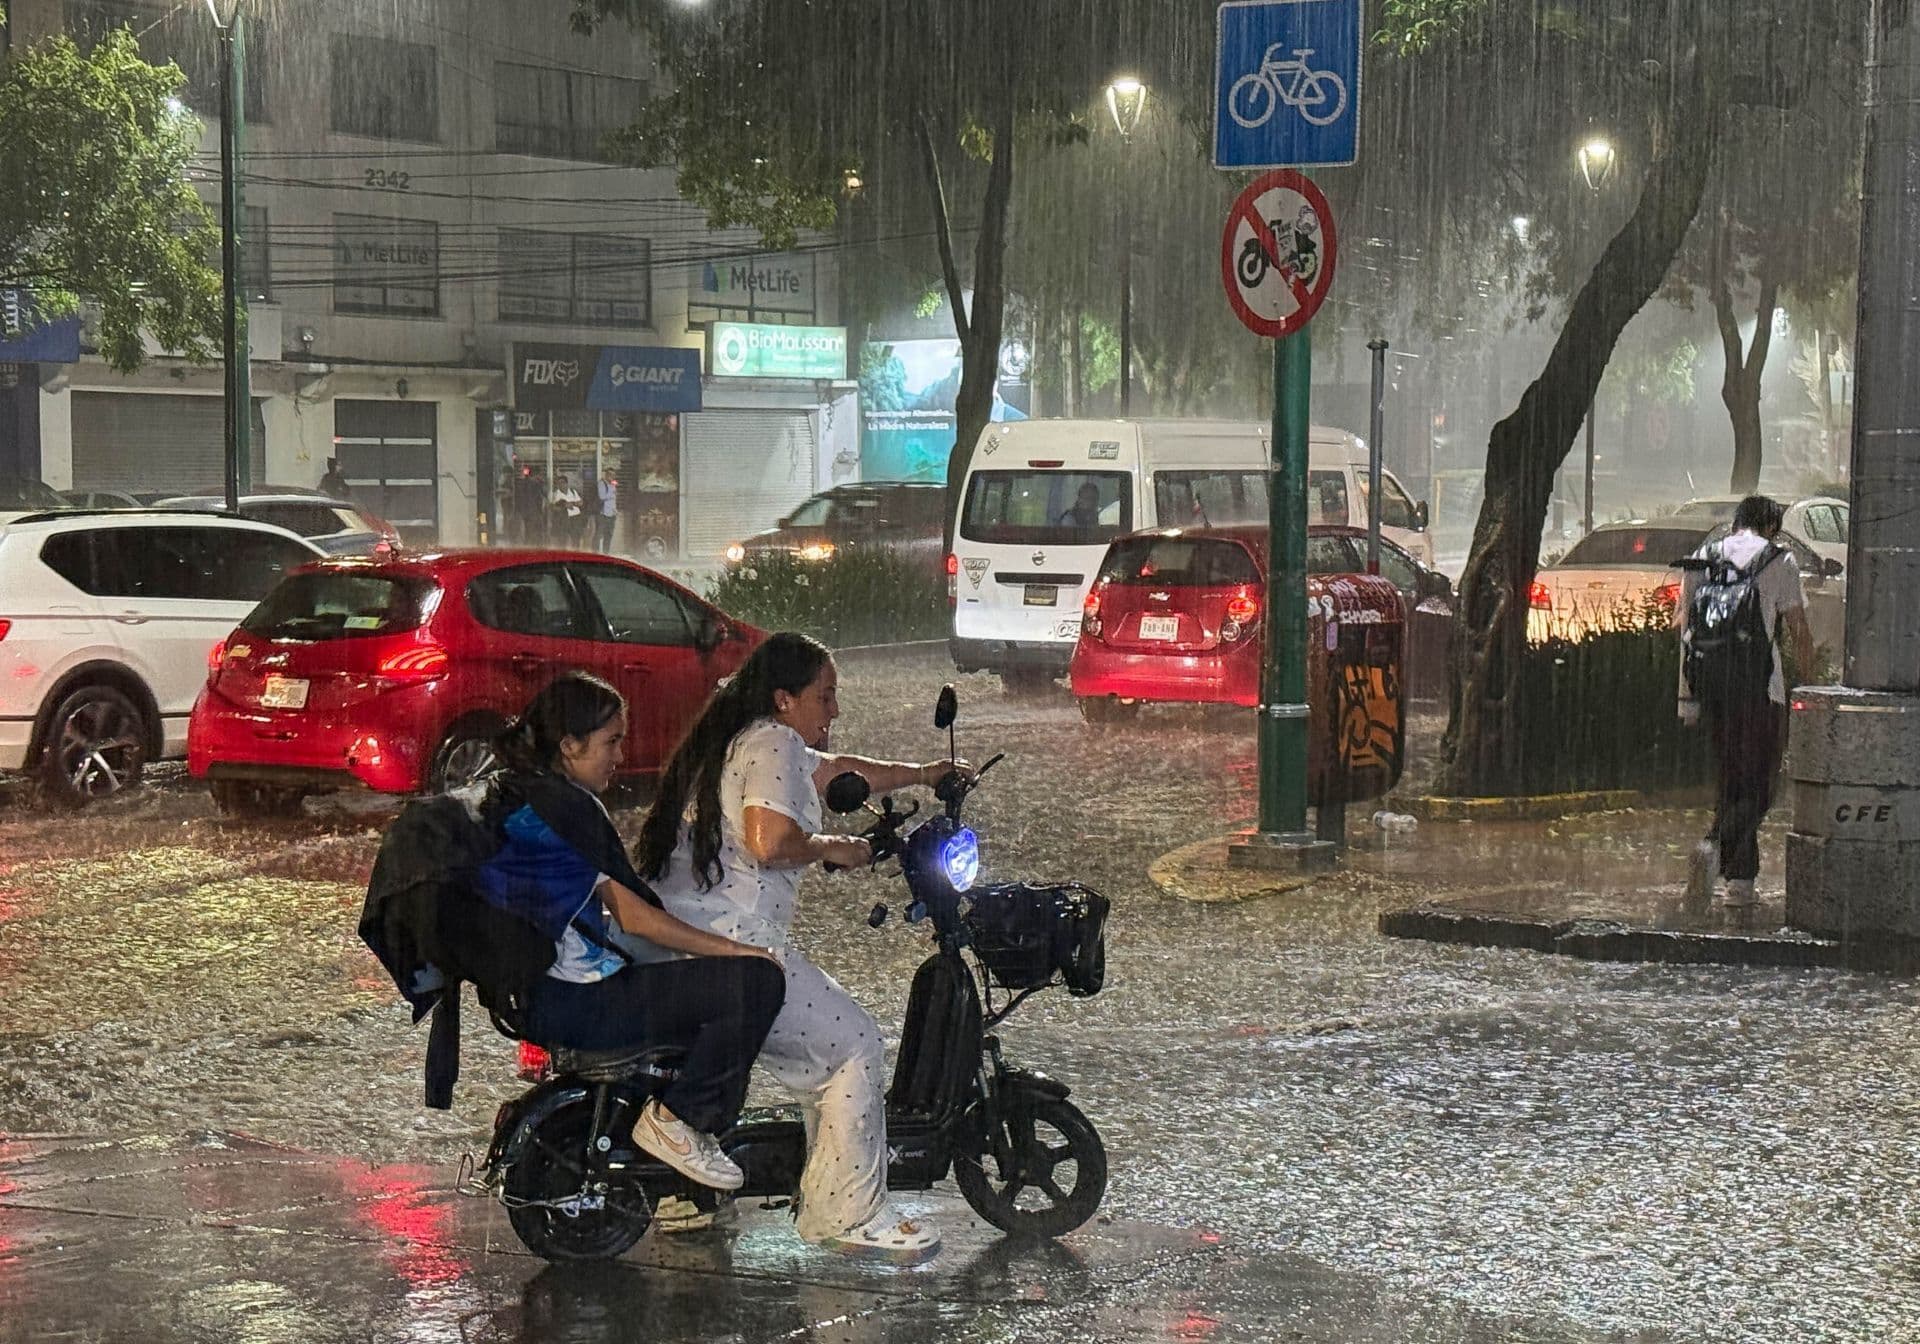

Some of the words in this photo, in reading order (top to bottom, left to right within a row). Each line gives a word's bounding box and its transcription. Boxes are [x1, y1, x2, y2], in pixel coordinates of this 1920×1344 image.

[365, 168, 410, 189] 2342
[362, 242, 429, 265] MetLife
[730, 266, 801, 293] MetLife
[523, 359, 557, 384] FOX
[625, 366, 683, 384] GIANT
[1835, 804, 1891, 823] CFE
